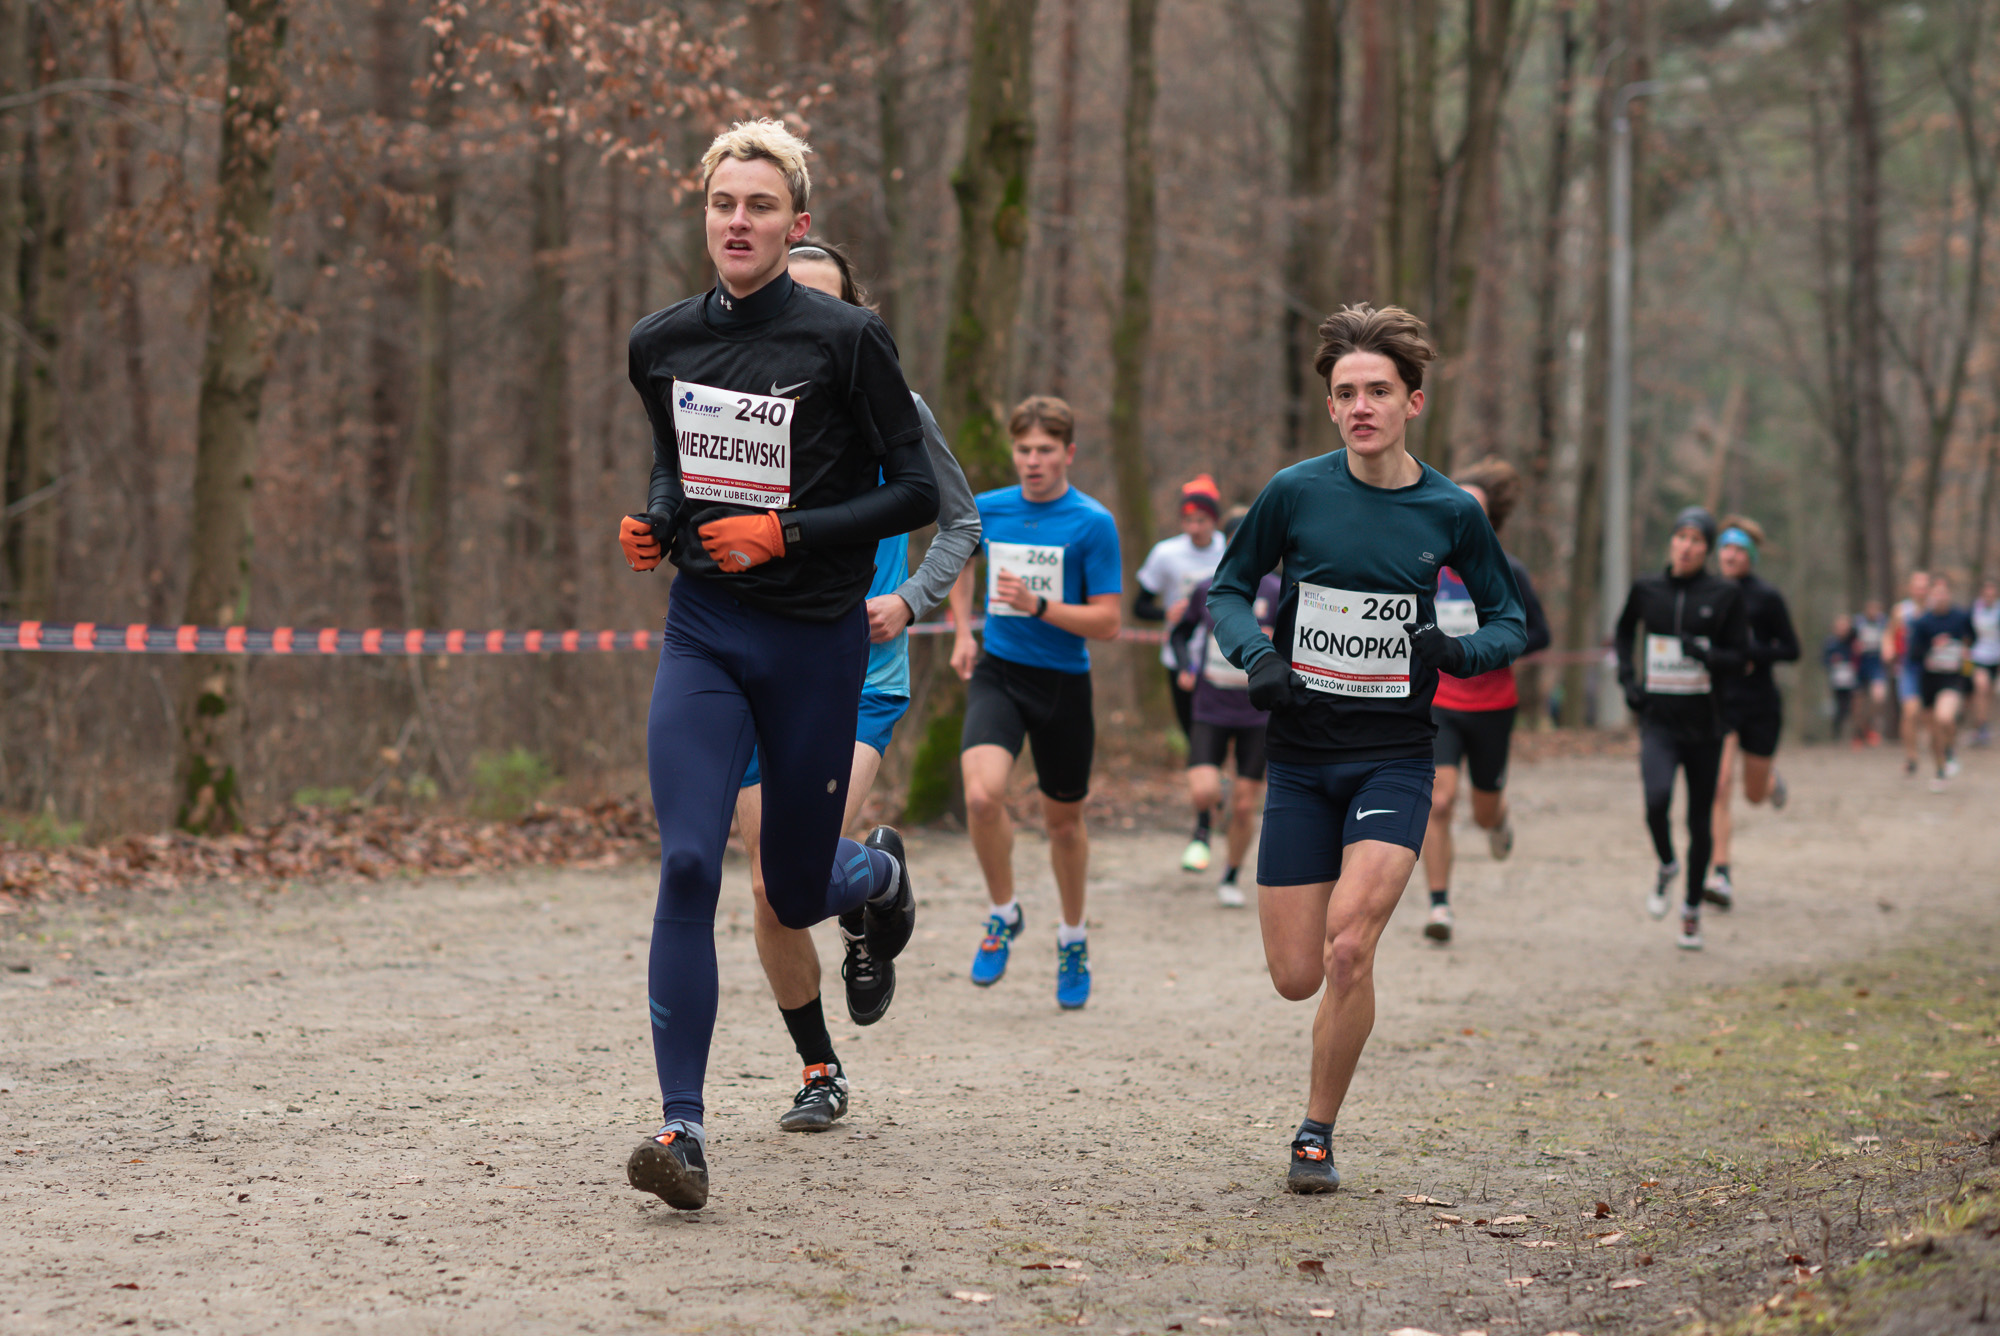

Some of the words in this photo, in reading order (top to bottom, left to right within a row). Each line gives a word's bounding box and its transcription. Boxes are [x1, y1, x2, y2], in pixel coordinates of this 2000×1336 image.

[687, 402, 721, 414] OLIMP
[735, 398, 786, 427] 240
[676, 428, 785, 469] MIERZEJEWSKI
[724, 490, 762, 502] LUBELSKI
[764, 495, 785, 505] 2021
[1027, 550, 1058, 566] 266
[1329, 604, 1341, 613] KIDS
[1361, 598, 1412, 621] 260
[1299, 625, 1408, 659] KONOPKA
[1347, 684, 1383, 693] LUBELSKI
[1385, 685, 1406, 694] 2021
